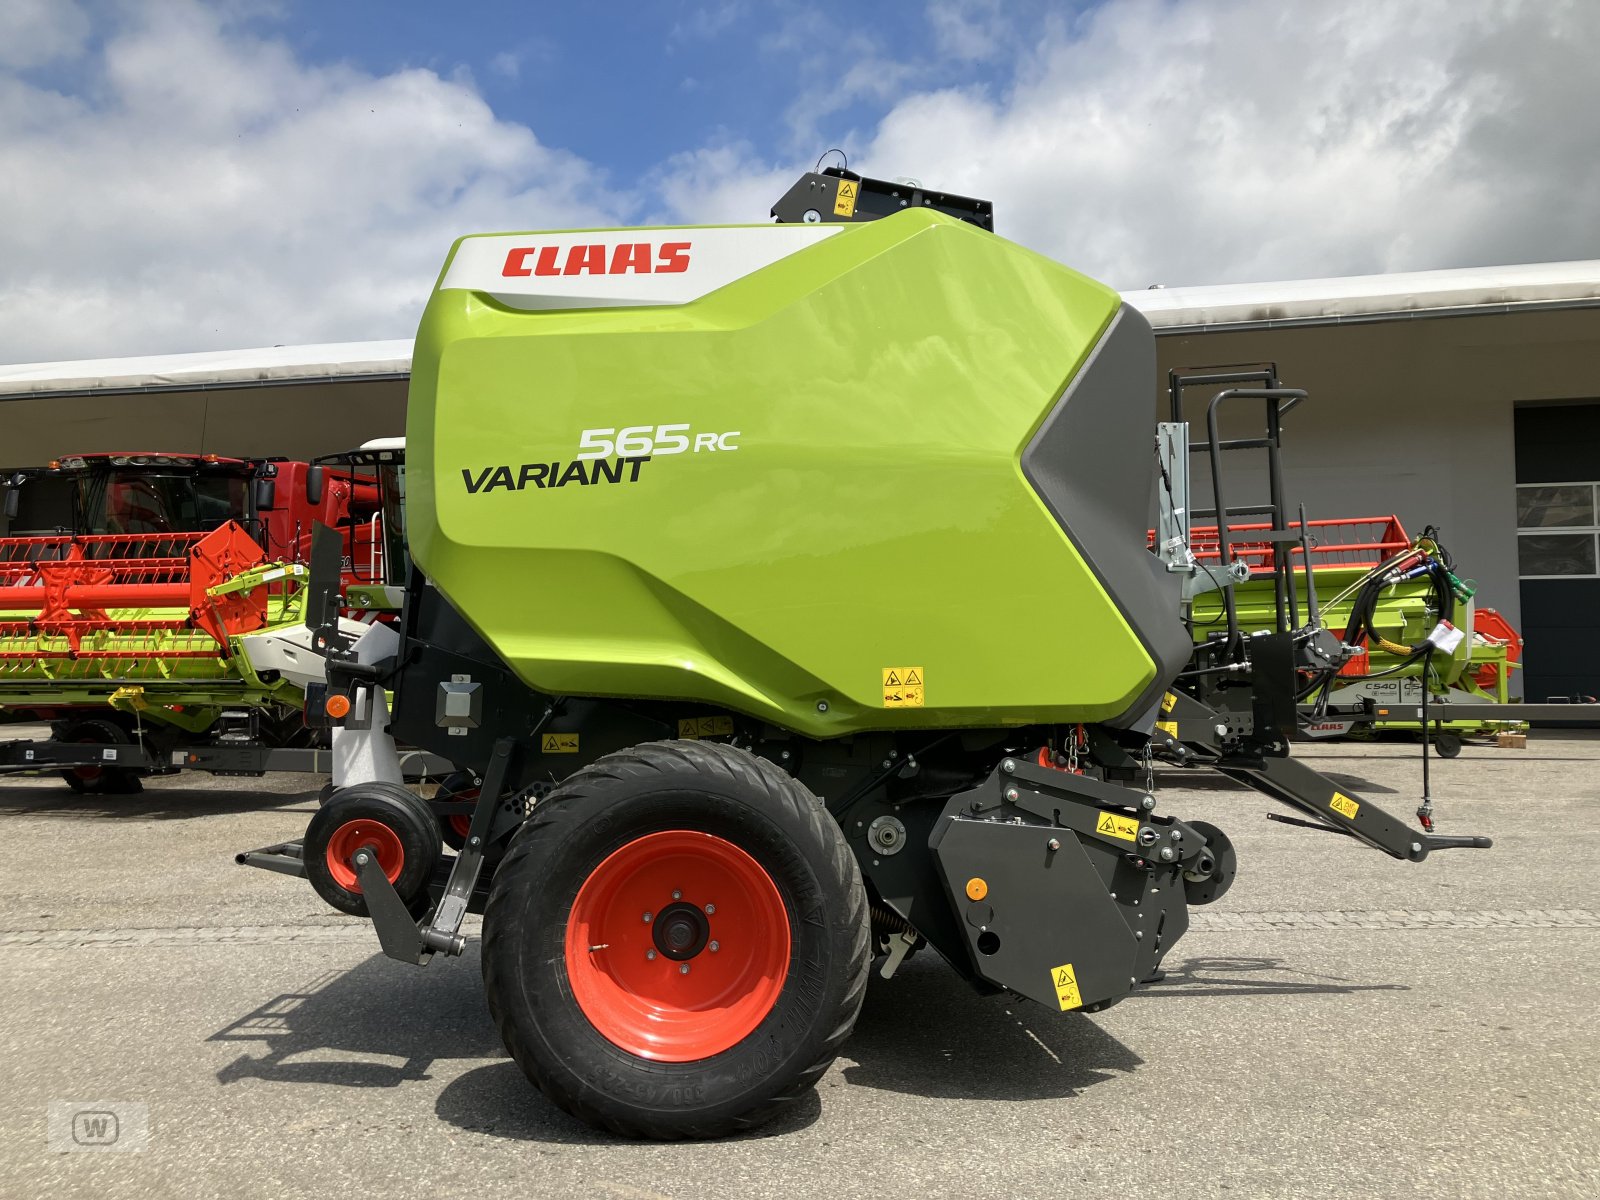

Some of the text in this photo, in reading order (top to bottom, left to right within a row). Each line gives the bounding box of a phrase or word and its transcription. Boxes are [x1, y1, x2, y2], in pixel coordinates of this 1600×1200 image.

[502, 242, 691, 277] CLAAS
[577, 424, 740, 461] 565 RC
[461, 455, 651, 494] VARIANT
[1310, 723, 1344, 731] CLAAS
